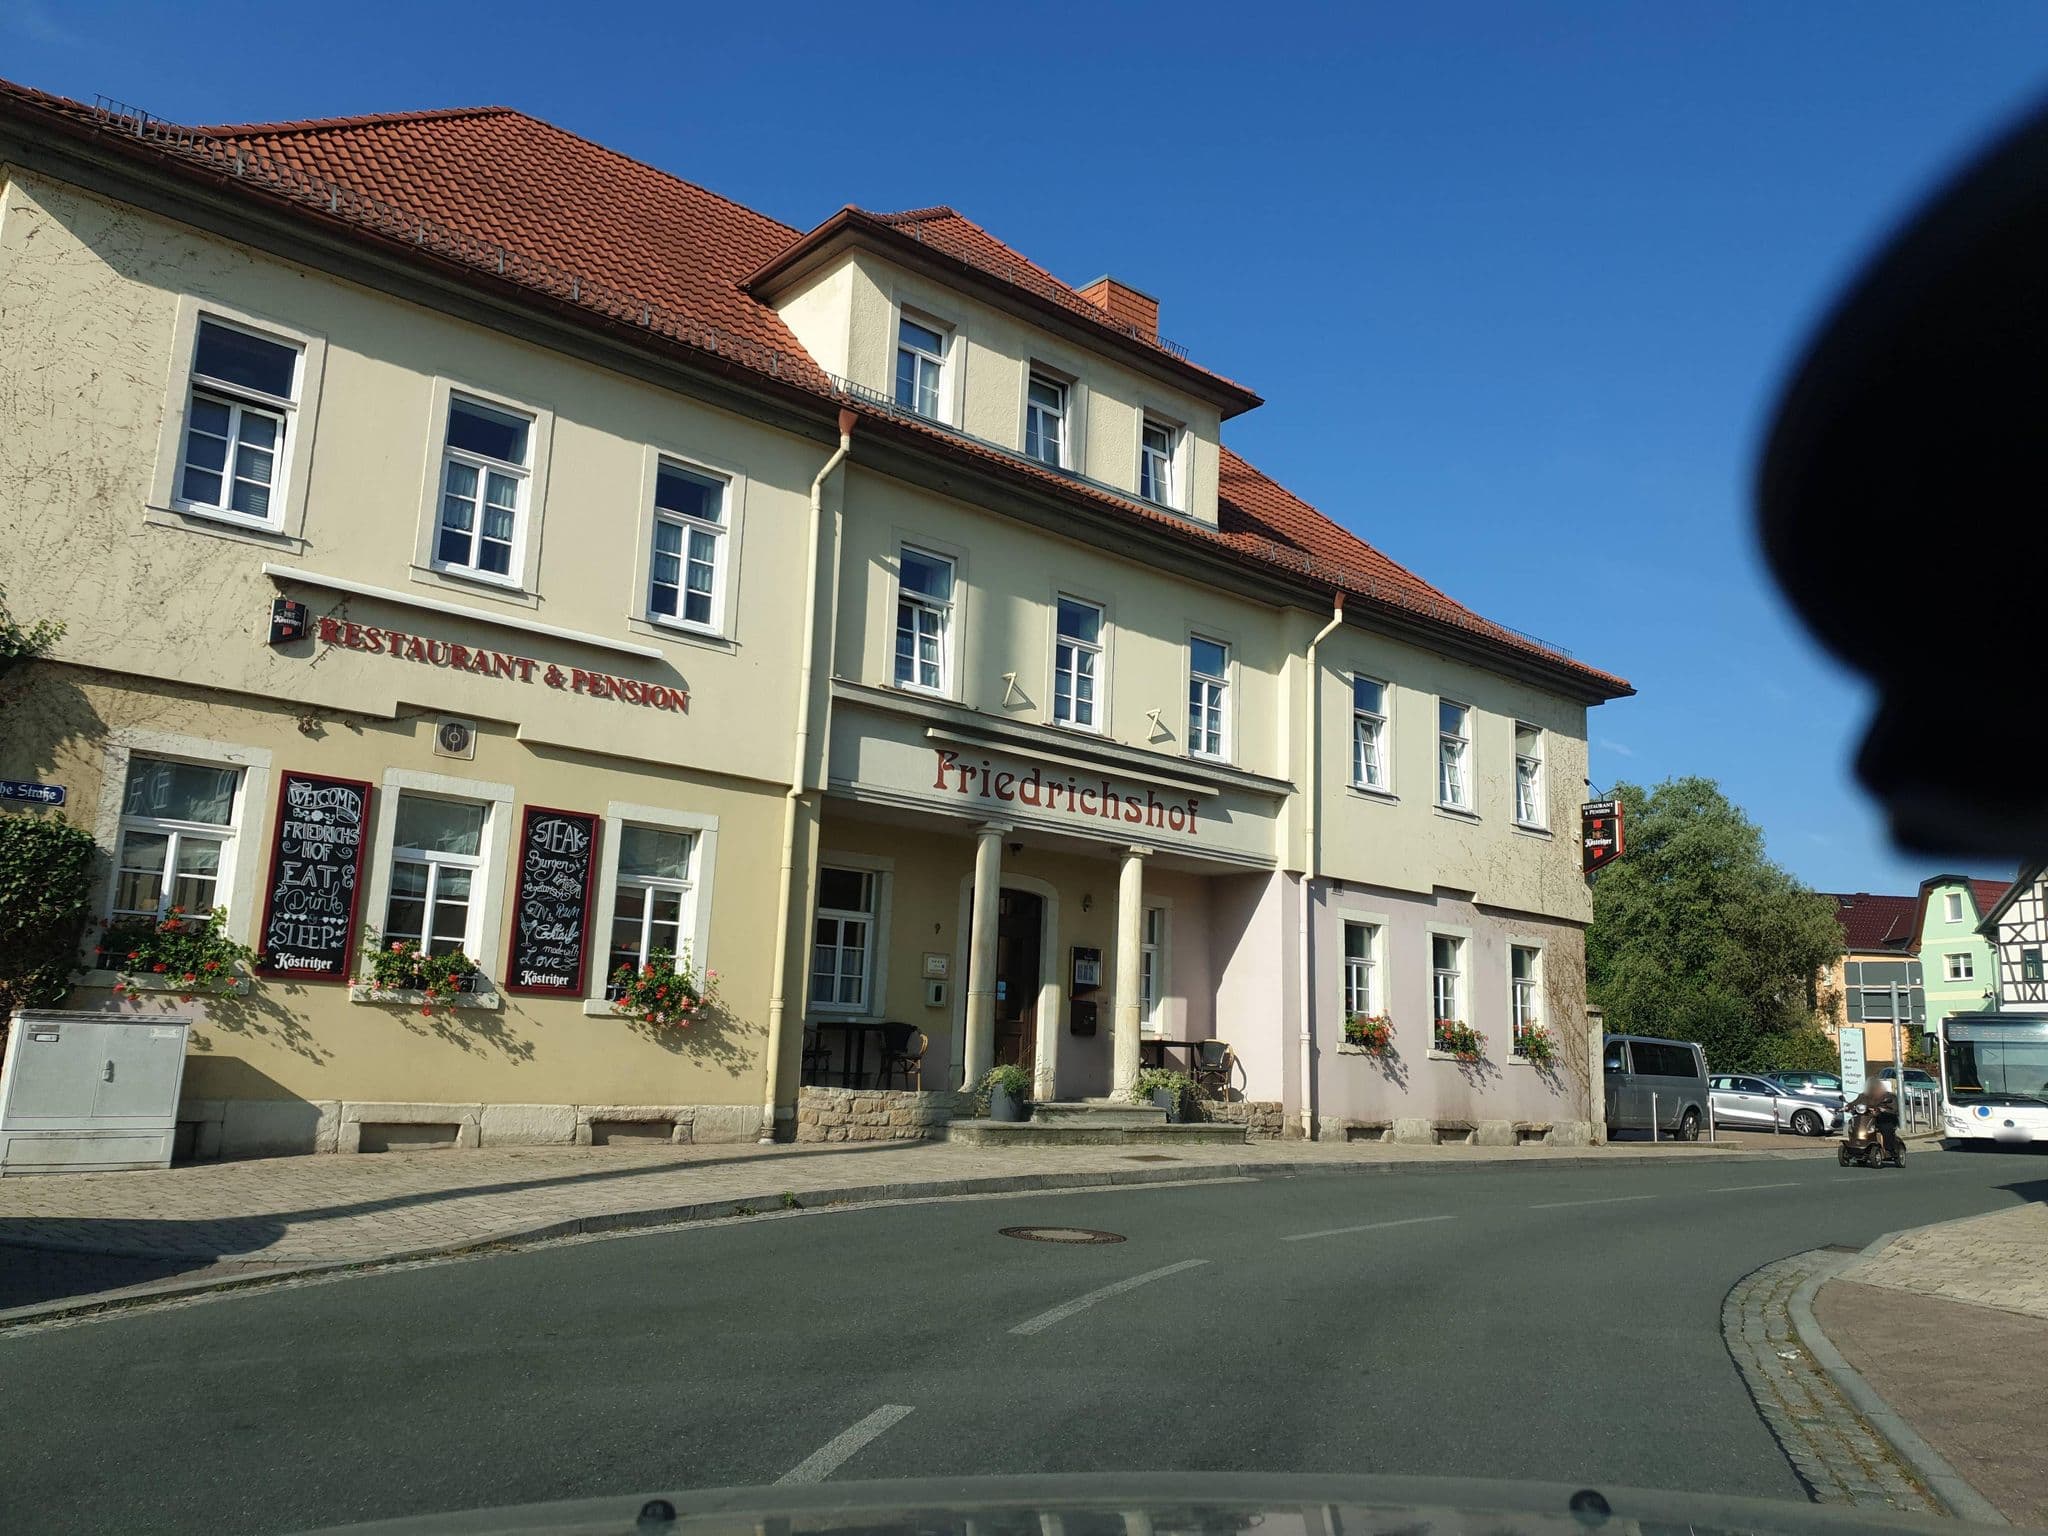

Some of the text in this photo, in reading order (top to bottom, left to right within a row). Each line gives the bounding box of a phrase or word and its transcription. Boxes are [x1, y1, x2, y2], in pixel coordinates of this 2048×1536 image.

[318, 616, 690, 713] RESTAURANT & PENSION
[18, 784, 56, 801] Straße
[290, 788, 357, 812] WELCOME
[933, 749, 1199, 834] Friedrichshof
[283, 821, 360, 845] FRIEDRICHS
[302, 841, 333, 861] HOF
[282, 861, 338, 888] EAT
[526, 850, 577, 881] Burger
[284, 881, 343, 915] Drink
[275, 922, 334, 949] SLEEP
[274, 953, 333, 971] Köstritzer
[521, 970, 569, 987] Köstritzer
